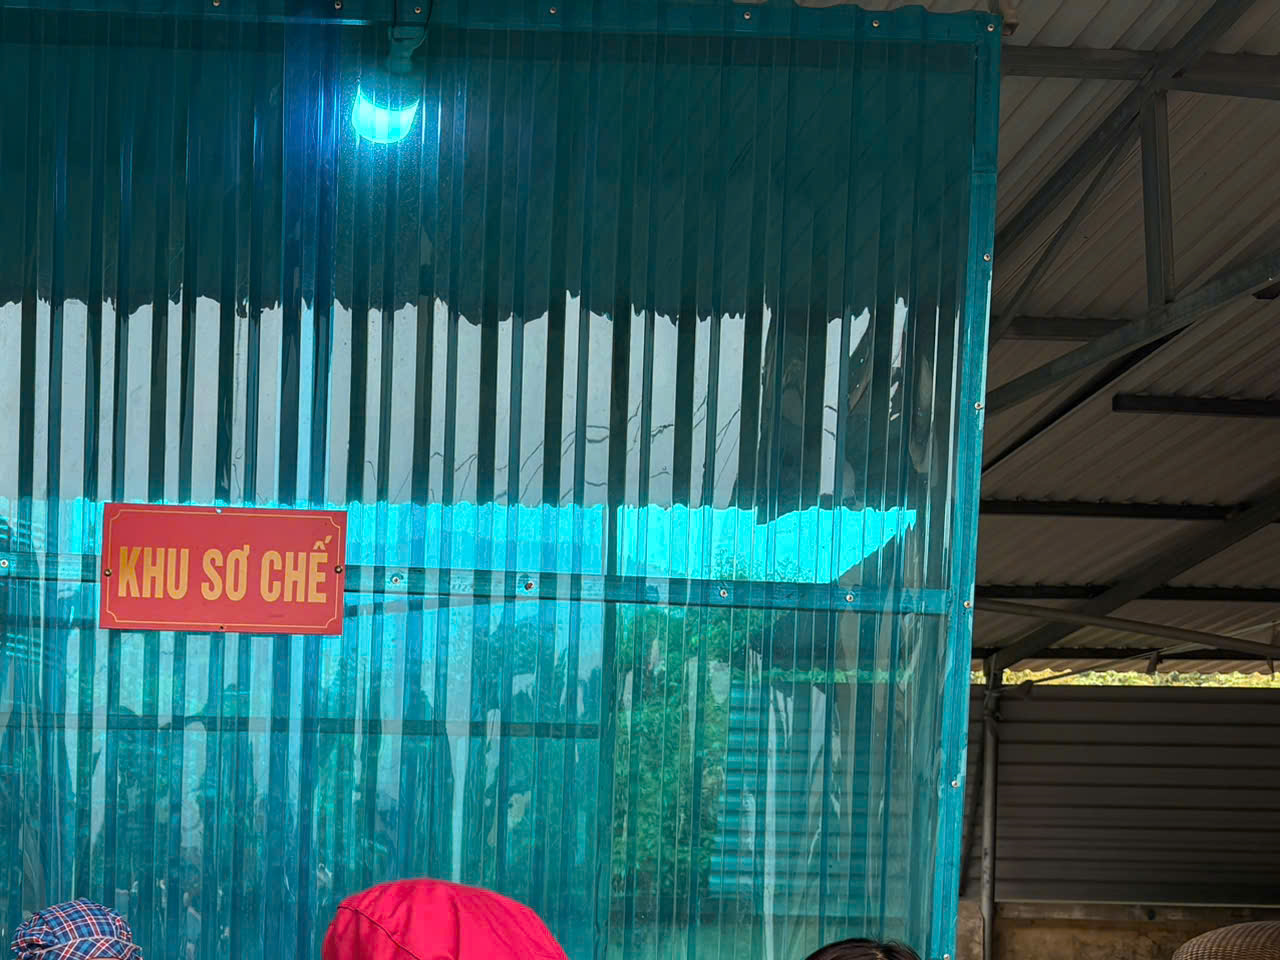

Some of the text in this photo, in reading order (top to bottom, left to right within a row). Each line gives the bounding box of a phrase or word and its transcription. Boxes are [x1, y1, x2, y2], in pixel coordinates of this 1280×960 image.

[118, 535, 333, 603] KHU SƠ CHẾ
